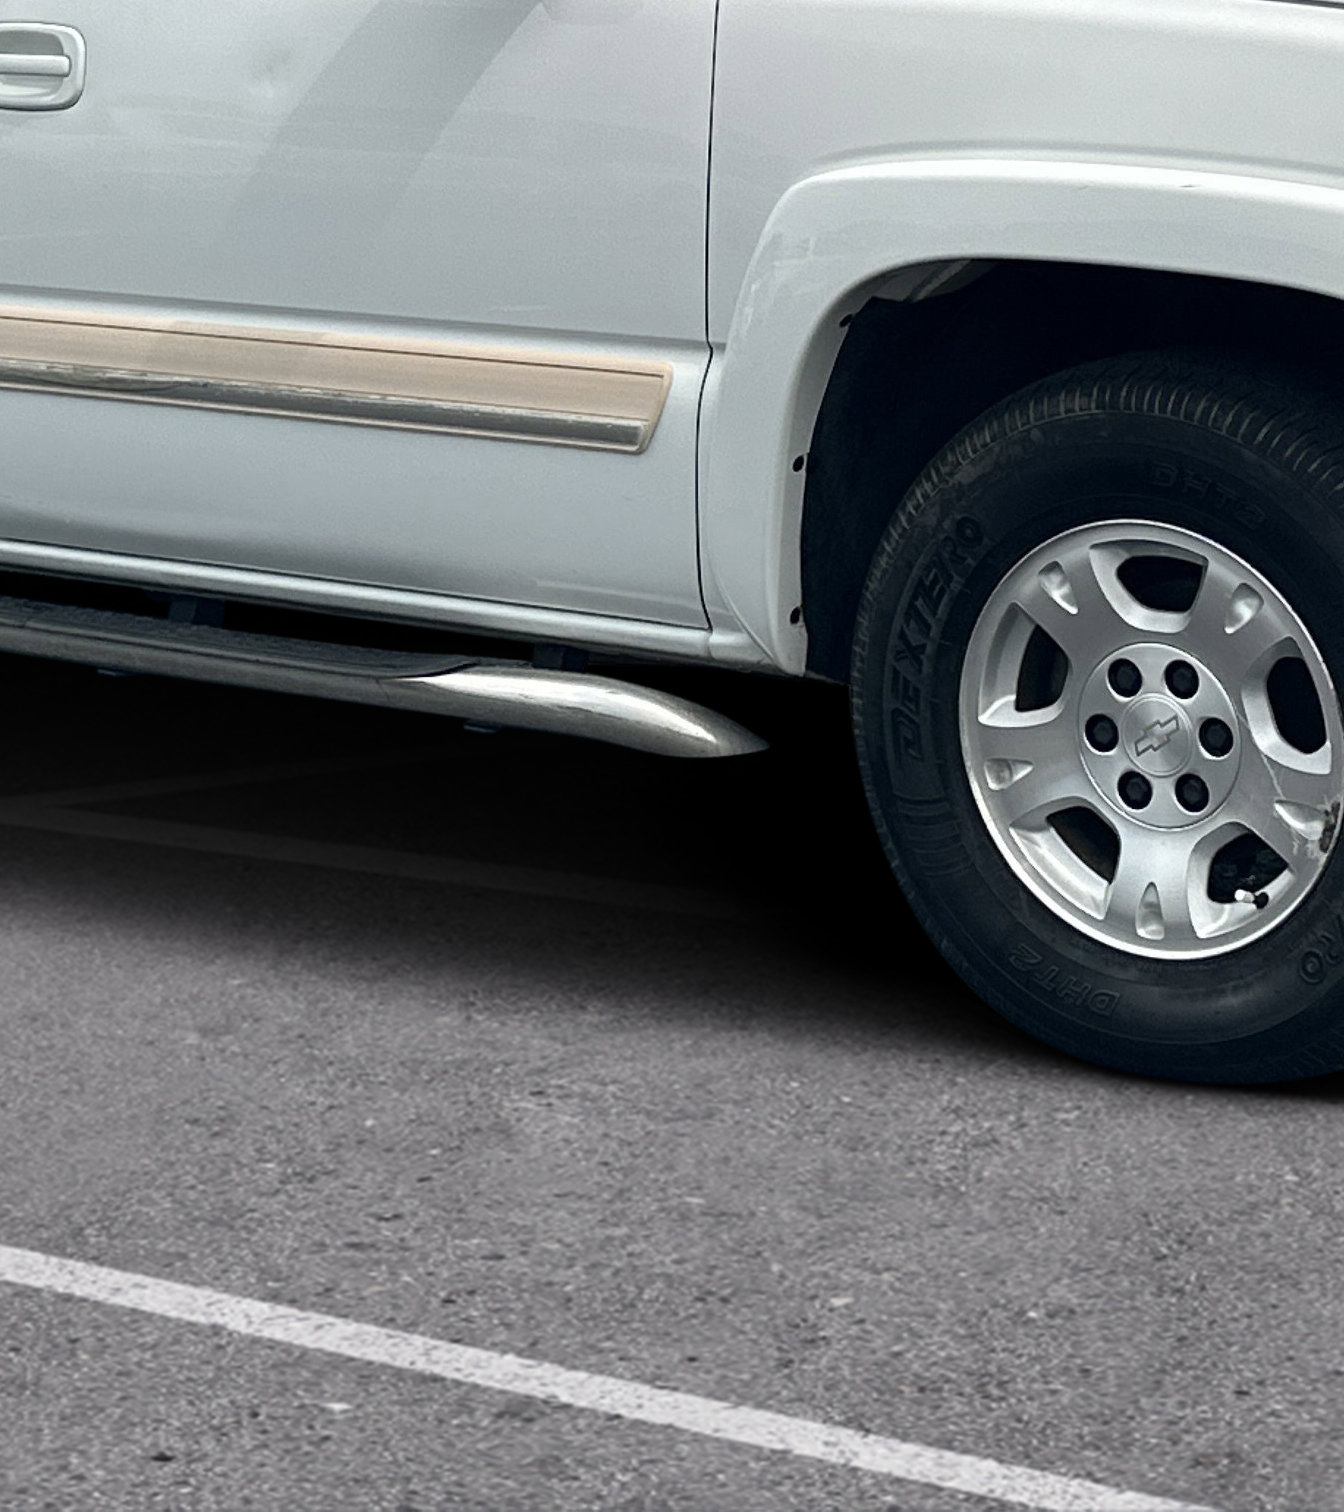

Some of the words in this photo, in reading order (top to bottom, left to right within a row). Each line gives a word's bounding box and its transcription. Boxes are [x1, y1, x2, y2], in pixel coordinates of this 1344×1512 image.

[1152, 464, 1267, 526] DHT2
[892, 514, 985, 762] DEXTERO
[1008, 941, 1122, 1018] DHT2
